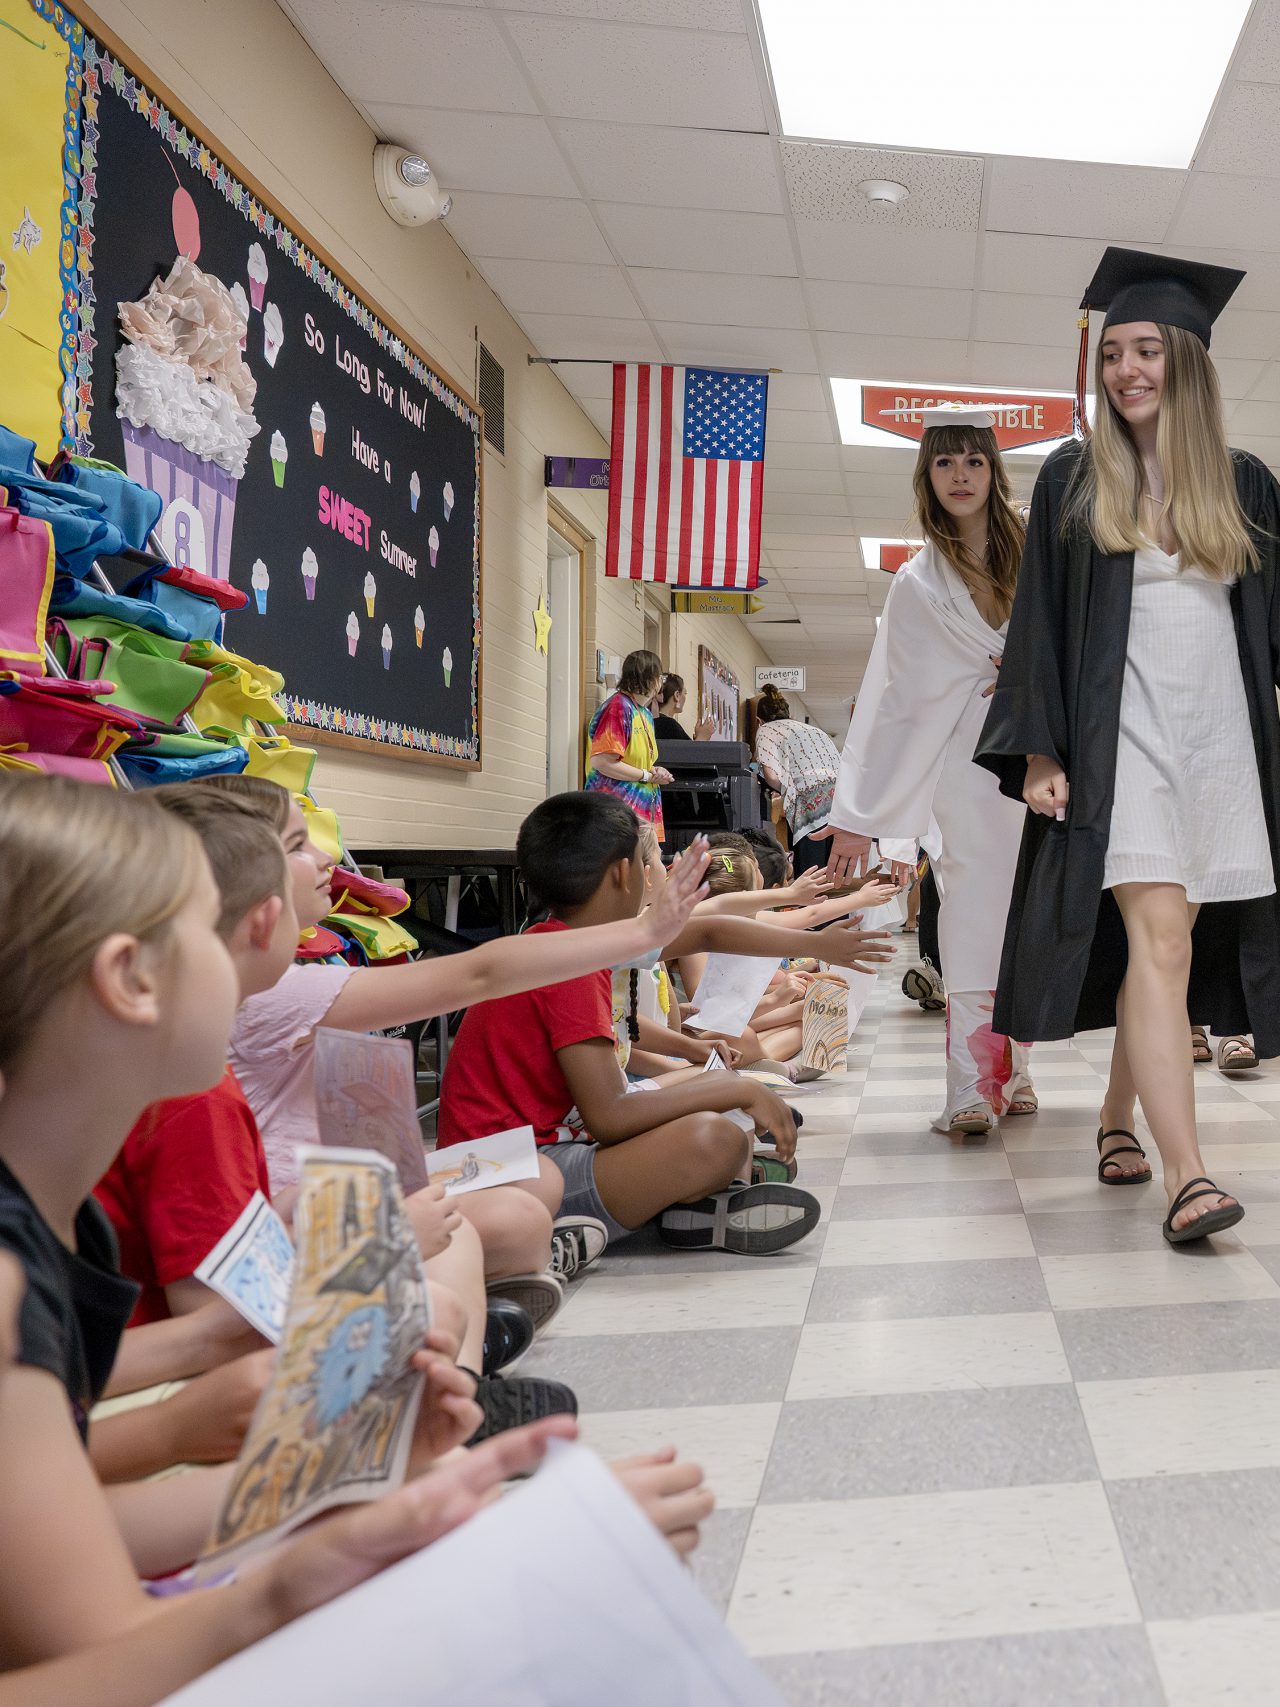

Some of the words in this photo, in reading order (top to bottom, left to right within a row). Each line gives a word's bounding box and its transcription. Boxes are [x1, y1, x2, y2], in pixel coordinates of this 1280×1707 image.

[305, 313, 325, 354] So
[336, 335, 371, 394] Long
[377, 368, 394, 408] For
[400, 387, 428, 432] Now!
[351, 426, 379, 473] Have
[384, 460, 391, 484] a
[318, 485, 371, 552] SWEET
[380, 530, 417, 578] Summer
[758, 669, 799, 680] Cafeteria
